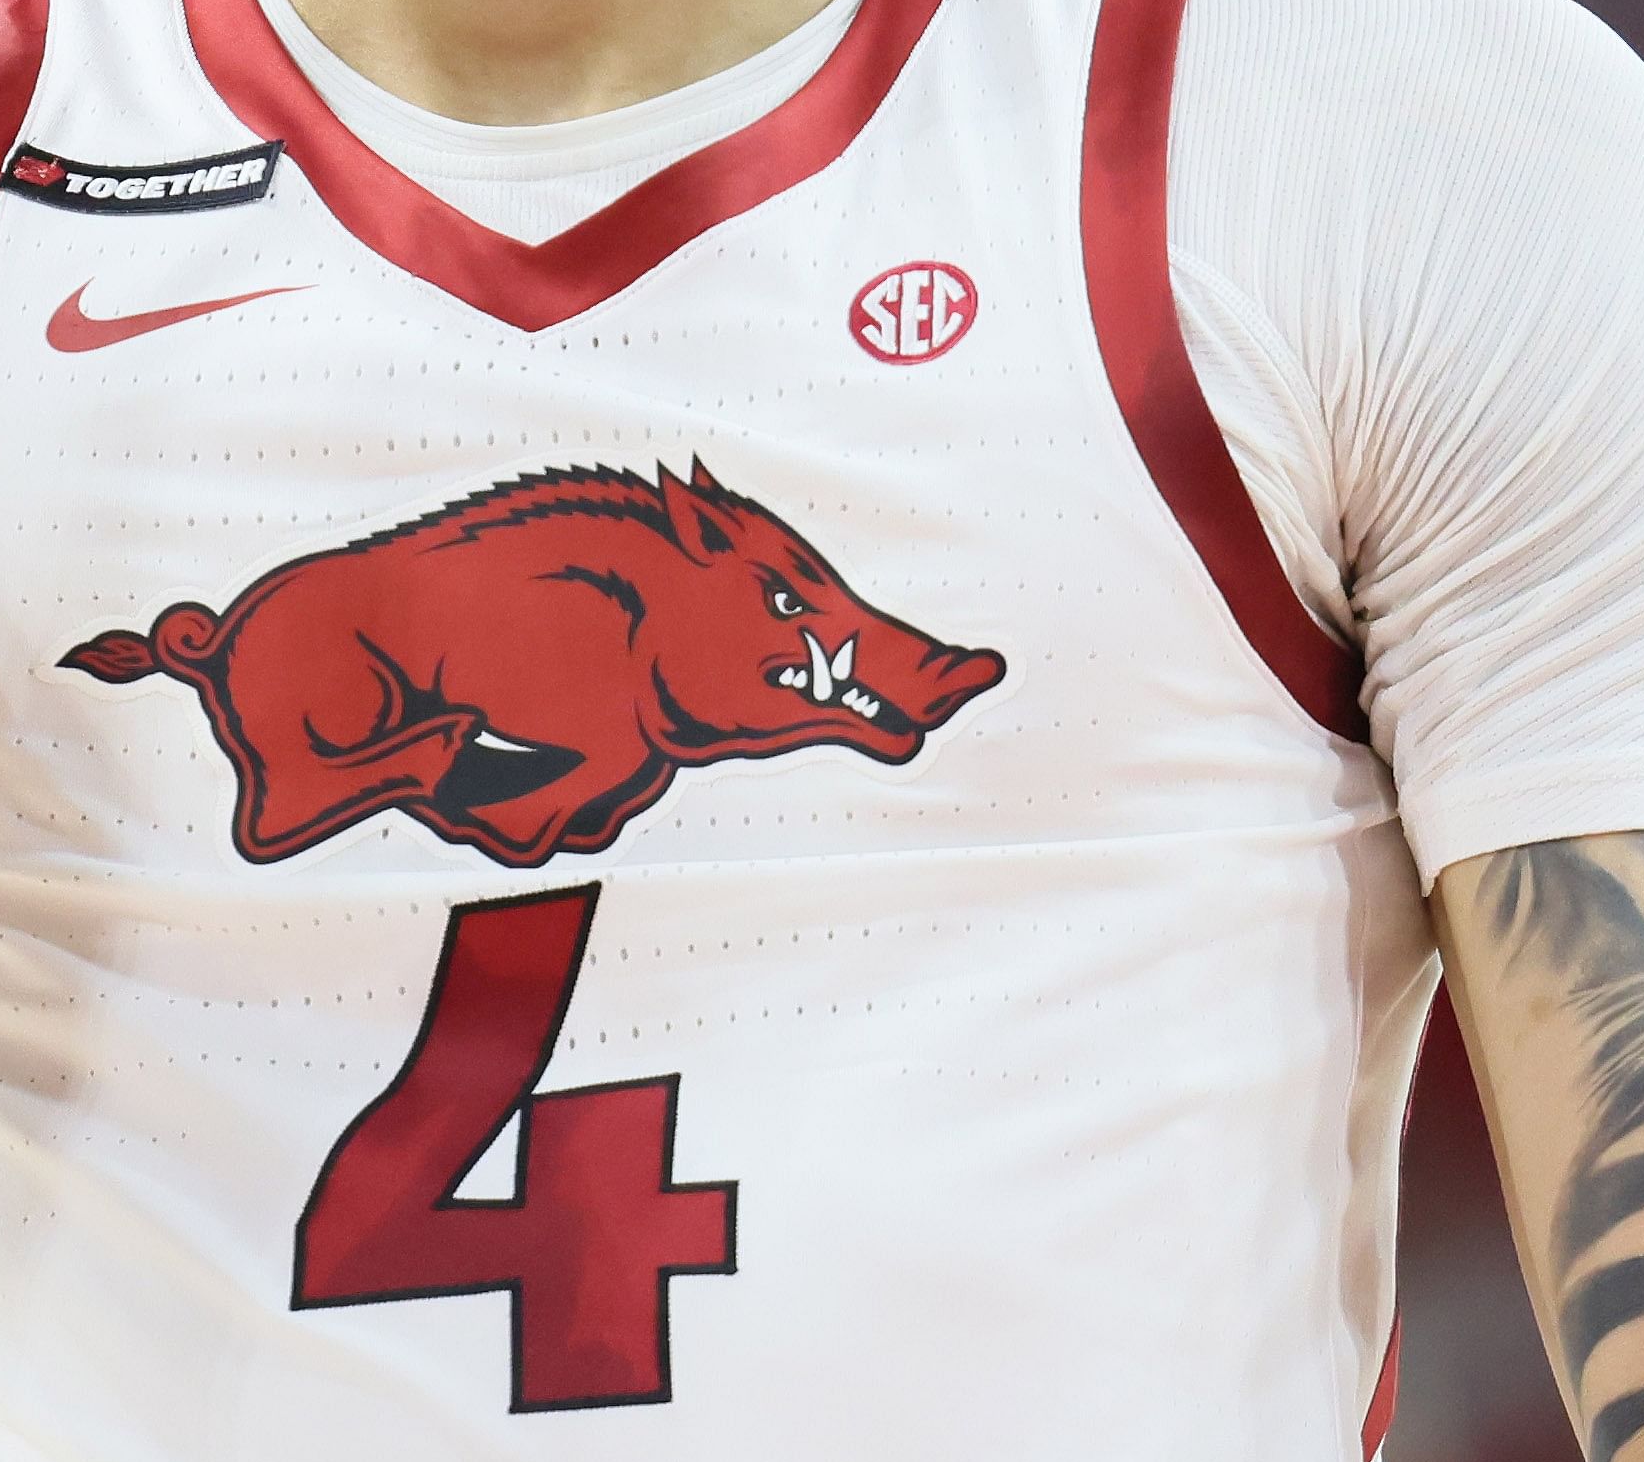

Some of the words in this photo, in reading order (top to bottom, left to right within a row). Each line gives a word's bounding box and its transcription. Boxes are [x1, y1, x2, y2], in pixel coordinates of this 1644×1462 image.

[66, 158, 268, 200] TOGETHER
[859, 268, 969, 356] SEC
[289, 880, 739, 1413] 4
